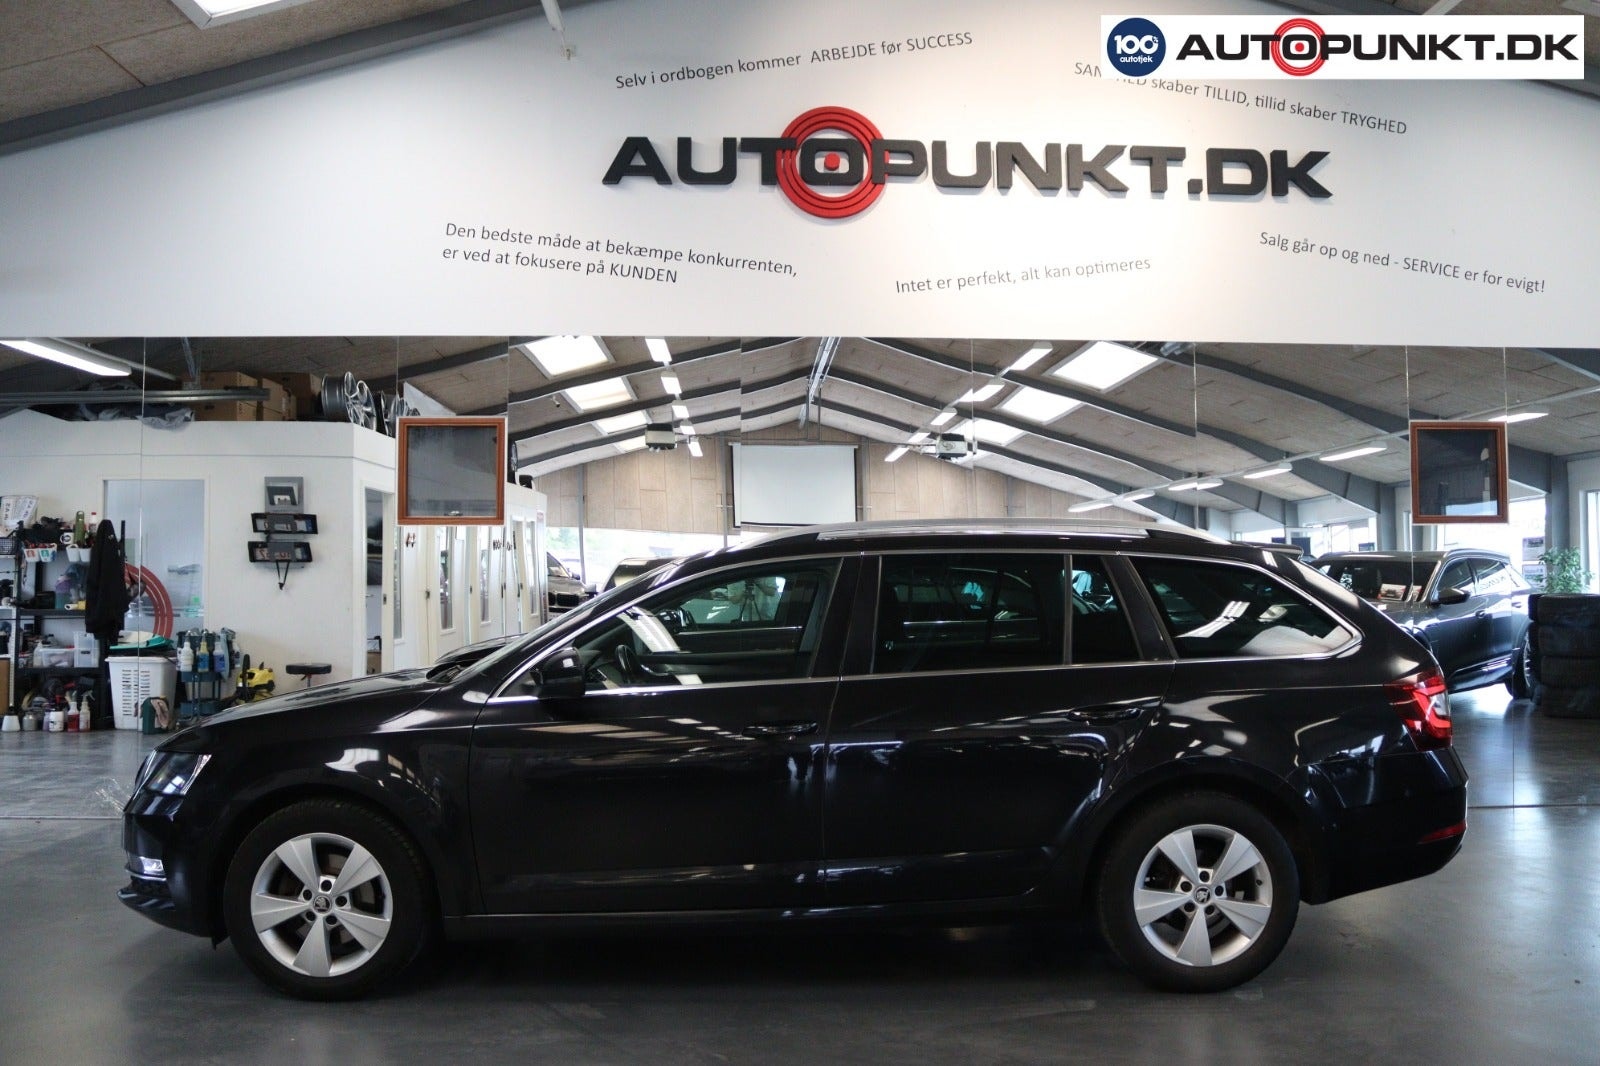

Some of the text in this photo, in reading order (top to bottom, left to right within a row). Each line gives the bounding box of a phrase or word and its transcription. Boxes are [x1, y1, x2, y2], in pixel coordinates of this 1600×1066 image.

[615, 32, 973, 89] Selv i ordbogen kommer ARBEJDE før SUCCESS
[1151, 78, 1200, 96] skaber
[1204, 85, 1250, 107] TILLID,
[1254, 94, 1286, 112] tillid
[1289, 102, 1337, 121] skaber
[1340, 111, 1407, 135] TRYGHED
[602, 136, 1334, 200] AUTOPUNKT.DK
[442, 248, 678, 284] er ved at fokusere på KUNDEN
[445, 223, 798, 278] Den bedste måde at bekæmpe konkurrenten,
[895, 259, 1152, 294] Intet er perfekt, alt kan optimeres
[1259, 232, 1290, 252] Salg
[1292, 237, 1317, 254] går
[1319, 245, 1338, 260] op
[1341, 249, 1361, 264] og
[1363, 252, 1390, 267] ned
[1402, 257, 1460, 279] SERVICE
[1464, 271, 1480, 282] er
[1482, 270, 1503, 285] for
[1506, 277, 1545, 294] evigt!
